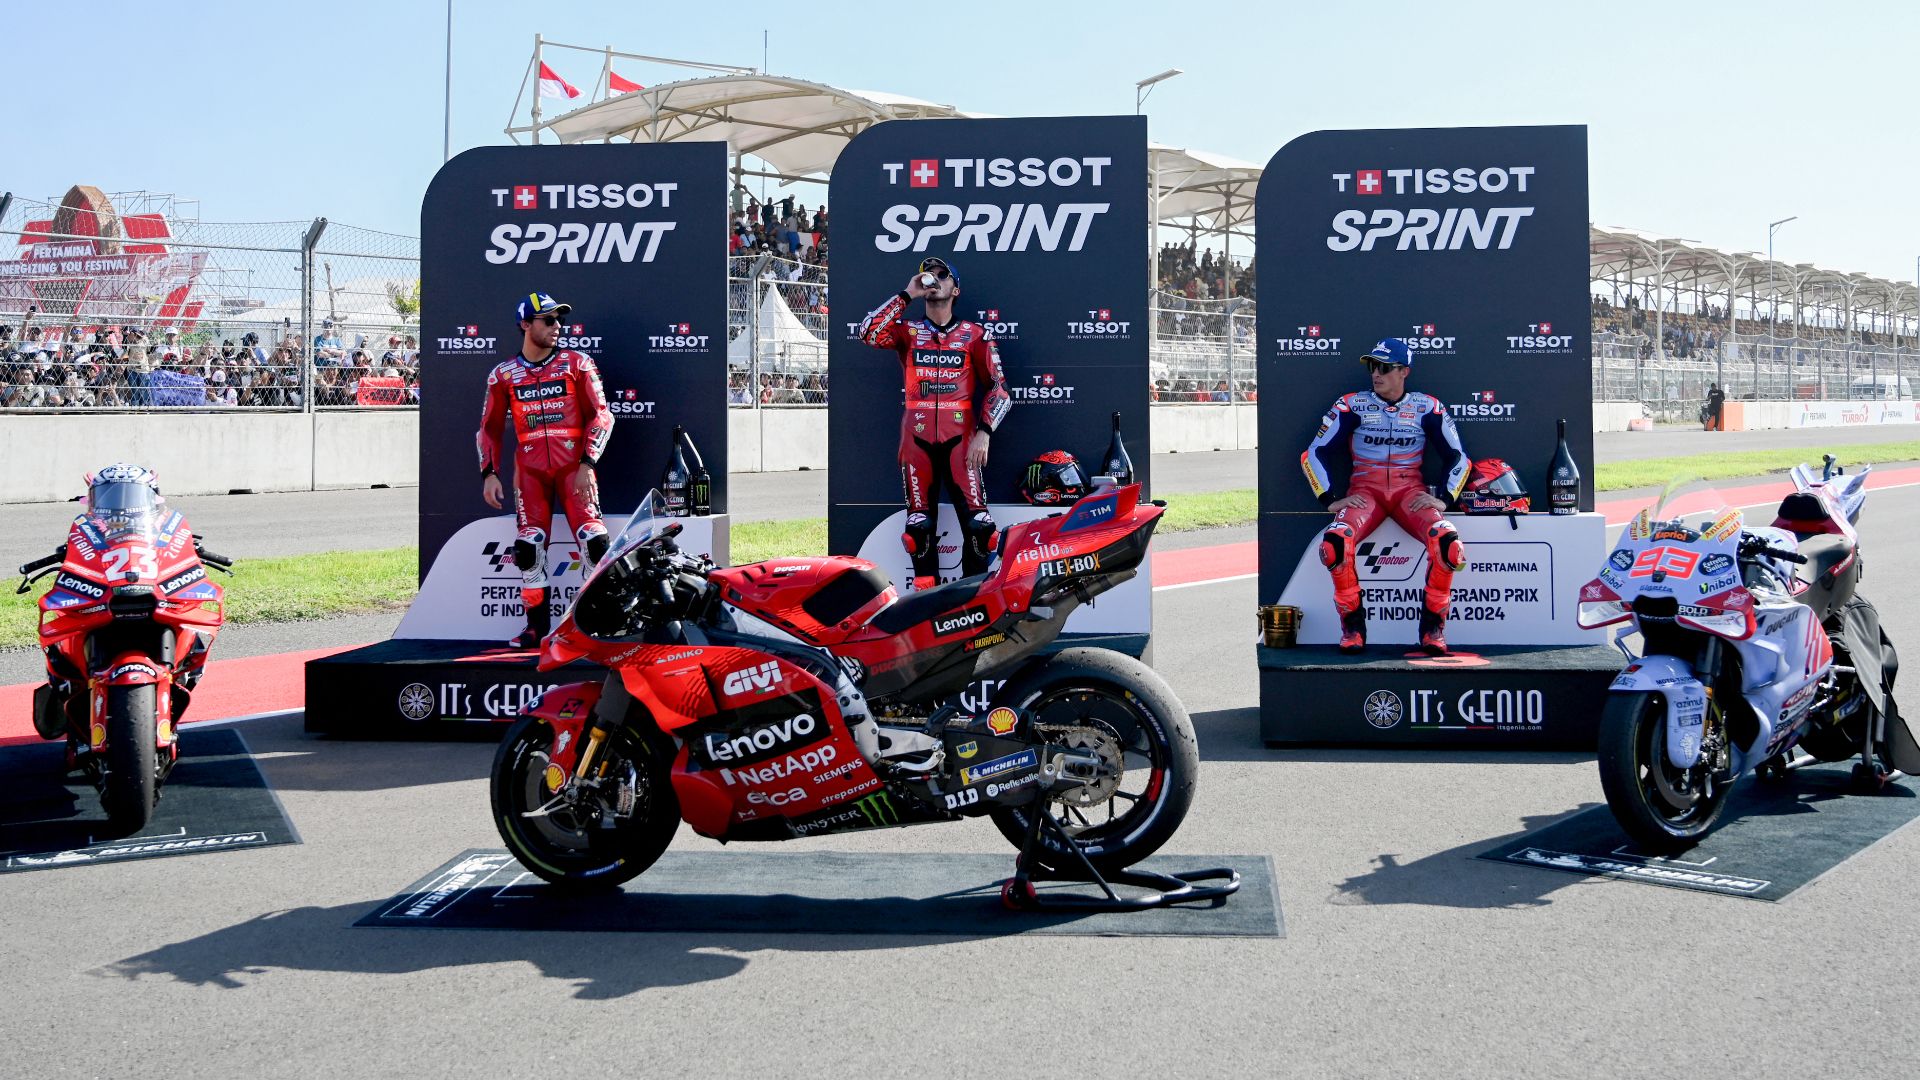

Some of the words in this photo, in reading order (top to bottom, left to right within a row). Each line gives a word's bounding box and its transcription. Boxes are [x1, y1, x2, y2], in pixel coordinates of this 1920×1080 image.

[883, 163, 904, 184] T
[944, 157, 1112, 187] TISSOT
[1332, 173, 1351, 192] T
[1387, 166, 1535, 194] TISSOT
[491, 189, 509, 207] T
[541, 183, 678, 209] TISSOT
[874, 203, 1111, 253] SPRINT
[1326, 207, 1535, 252] SPRINT
[485, 221, 677, 264] SPRINT
[33, 246, 92, 259] PERTAMINA
[61, 261, 82, 272] YOU
[85, 259, 129, 271] FESTIVAL
[1088, 310, 1097, 319] T
[457, 326, 466, 335] T
[669, 324, 677, 333] T
[1067, 322, 1130, 334] TISSOT
[1298, 326, 1306, 335] T
[1528, 324, 1538, 333] T
[437, 338, 497, 349] TISSOT
[554, 336, 602, 348] ISSOT
[648, 336, 709, 348] TISSOT
[1276, 338, 1341, 350] TISSOT
[1506, 336, 1572, 348] TISSOT
[915, 352, 962, 365] Lenovo
[1033, 375, 1041, 384] T
[517, 385, 562, 400] Lenovo
[615, 390, 624, 399] T
[1012, 386, 1074, 399] TISSOT
[1471, 392, 1481, 401] T
[607, 401, 656, 413] ISSOT
[1450, 404, 1515, 416] TISSOT
[1363, 435, 1417, 447] DUCATI
[1490, 499, 1506, 507] Bull
[1090, 504, 1112, 517] TIM
[170, 528, 192, 553] riello
[72, 535, 96, 561] riello
[1016, 543, 1059, 564] riello
[102, 546, 158, 582] 23
[773, 564, 811, 573] DUCATI
[1040, 552, 1101, 577] FLEX-BOX
[1471, 562, 1538, 572] PERTAMINA
[1629, 546, 1701, 579] 93
[1702, 555, 1728, 569] Estrella
[1705, 561, 1729, 573] Galicia
[57, 573, 104, 598] Lenovo
[159, 568, 207, 594] Lenovo
[1601, 567, 1623, 590] Unibat
[1699, 574, 1737, 595] Unibat
[1450, 588, 1501, 602] GRAND
[1504, 588, 1539, 602] PRIX
[60, 598, 79, 607] TIM
[481, 604, 498, 617] OF
[1464, 606, 1505, 621] 2024
[1678, 605, 1708, 615] BOLD
[934, 611, 985, 633] Lenovo
[1765, 609, 1799, 636] DUCATI
[667, 648, 704, 661] DAIKO
[111, 664, 156, 679] Lenovo
[723, 660, 783, 696] GIVI
[1457, 689, 1543, 724] GENIO
[1138, 702, 1166, 742] MICHELIN
[705, 713, 815, 762] Lenovo
[738, 744, 837, 786] NetApp
[813, 758, 863, 785] SIEMENS
[982, 755, 1029, 776] MICHELIN
[821, 778, 878, 805] streparava
[404, 873, 477, 916] MICHELIN
